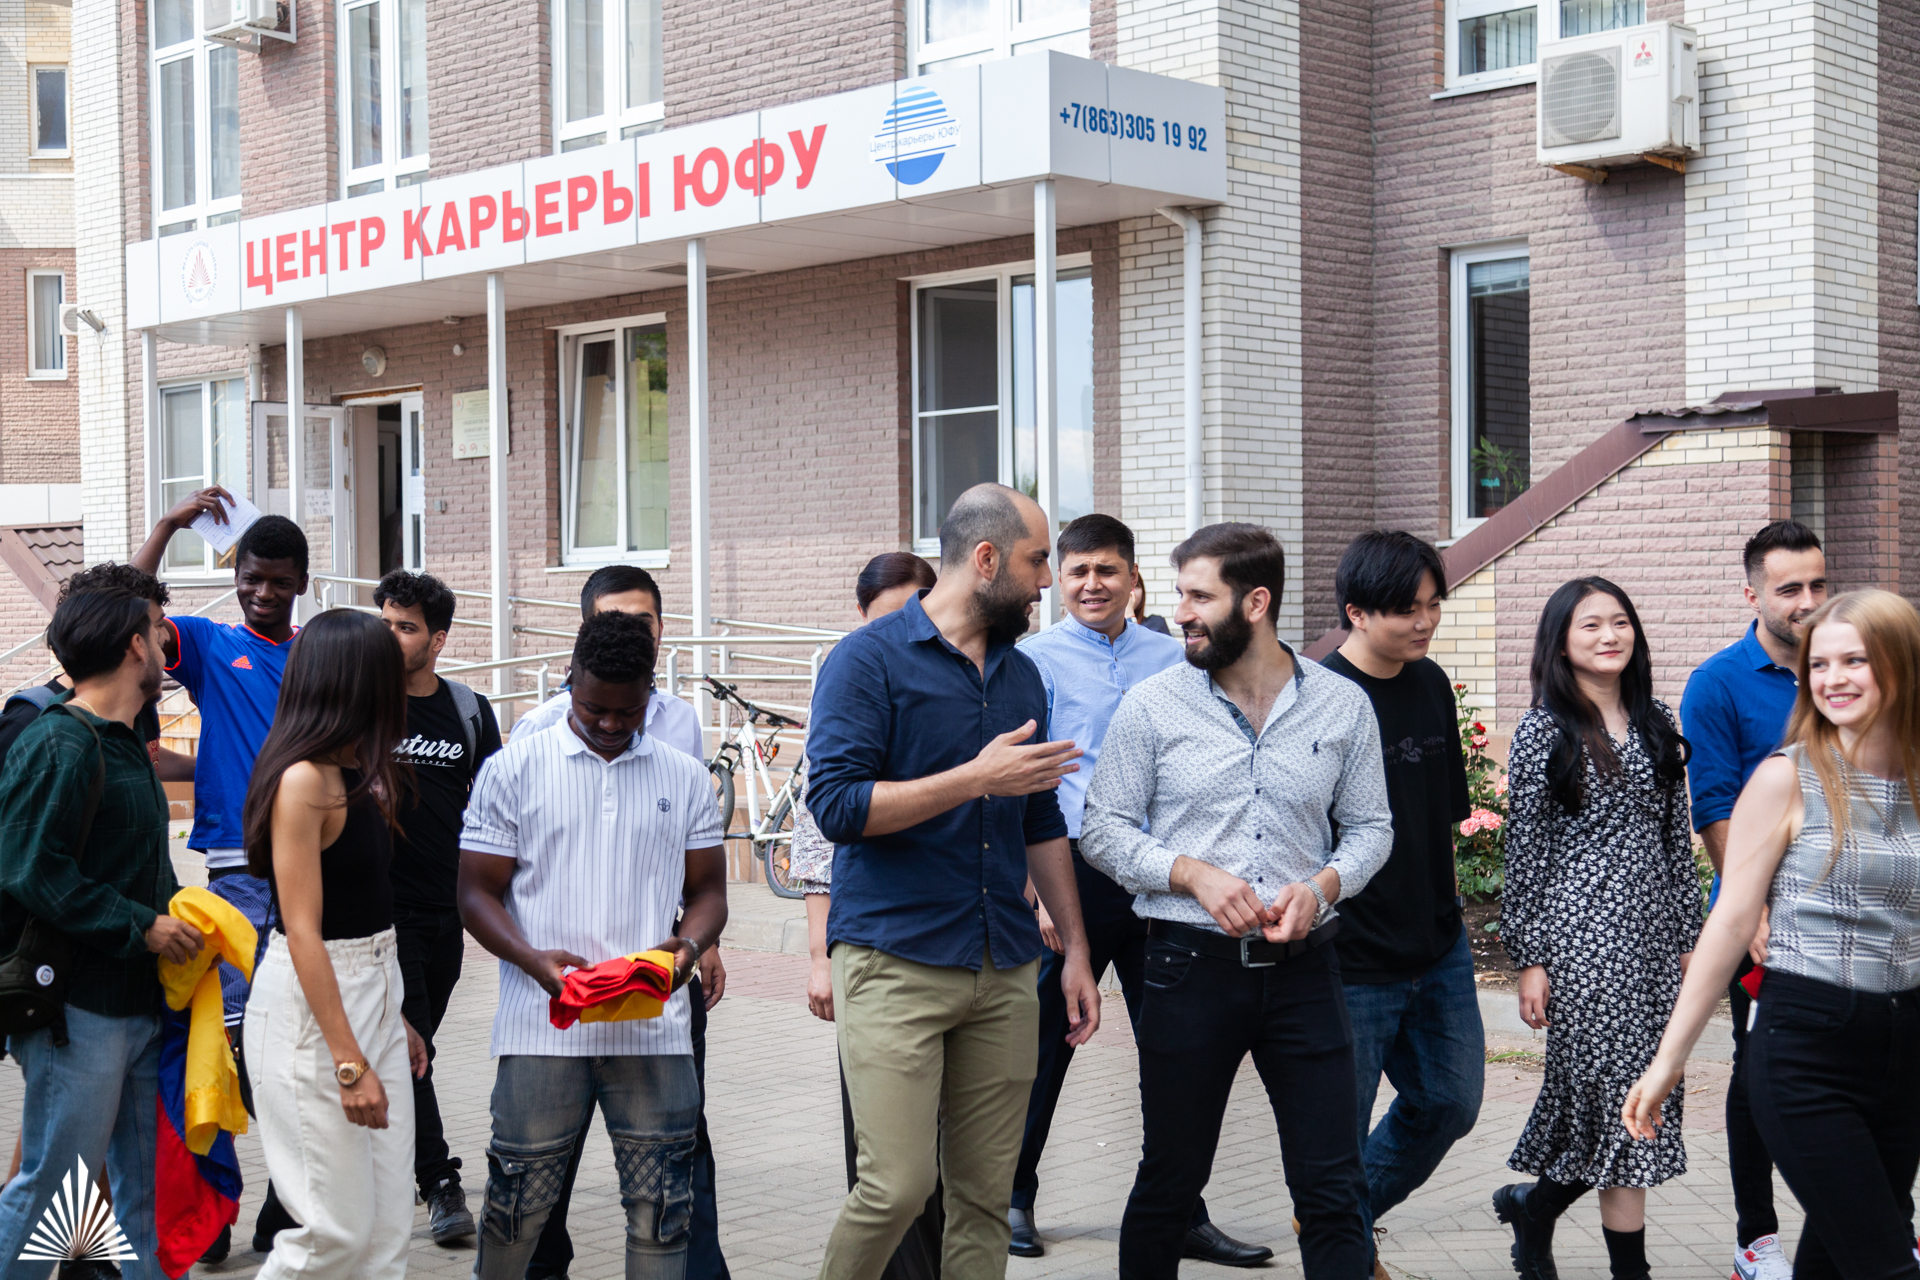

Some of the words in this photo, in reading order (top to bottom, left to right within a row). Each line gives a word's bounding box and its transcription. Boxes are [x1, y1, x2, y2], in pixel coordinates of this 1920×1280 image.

[869, 139, 897, 154] Центр
[898, 132, 936, 148] карьеры
[938, 124, 962, 138] ЮФУ
[1060, 102, 1155, 142] +7(863)305
[1162, 121, 1182, 148] 19
[1188, 125, 1207, 152] 92
[246, 216, 386, 296] ЦЕНТР
[403, 162, 651, 260] КАРЬЕРЫ
[673, 124, 829, 213] ЮФУ
